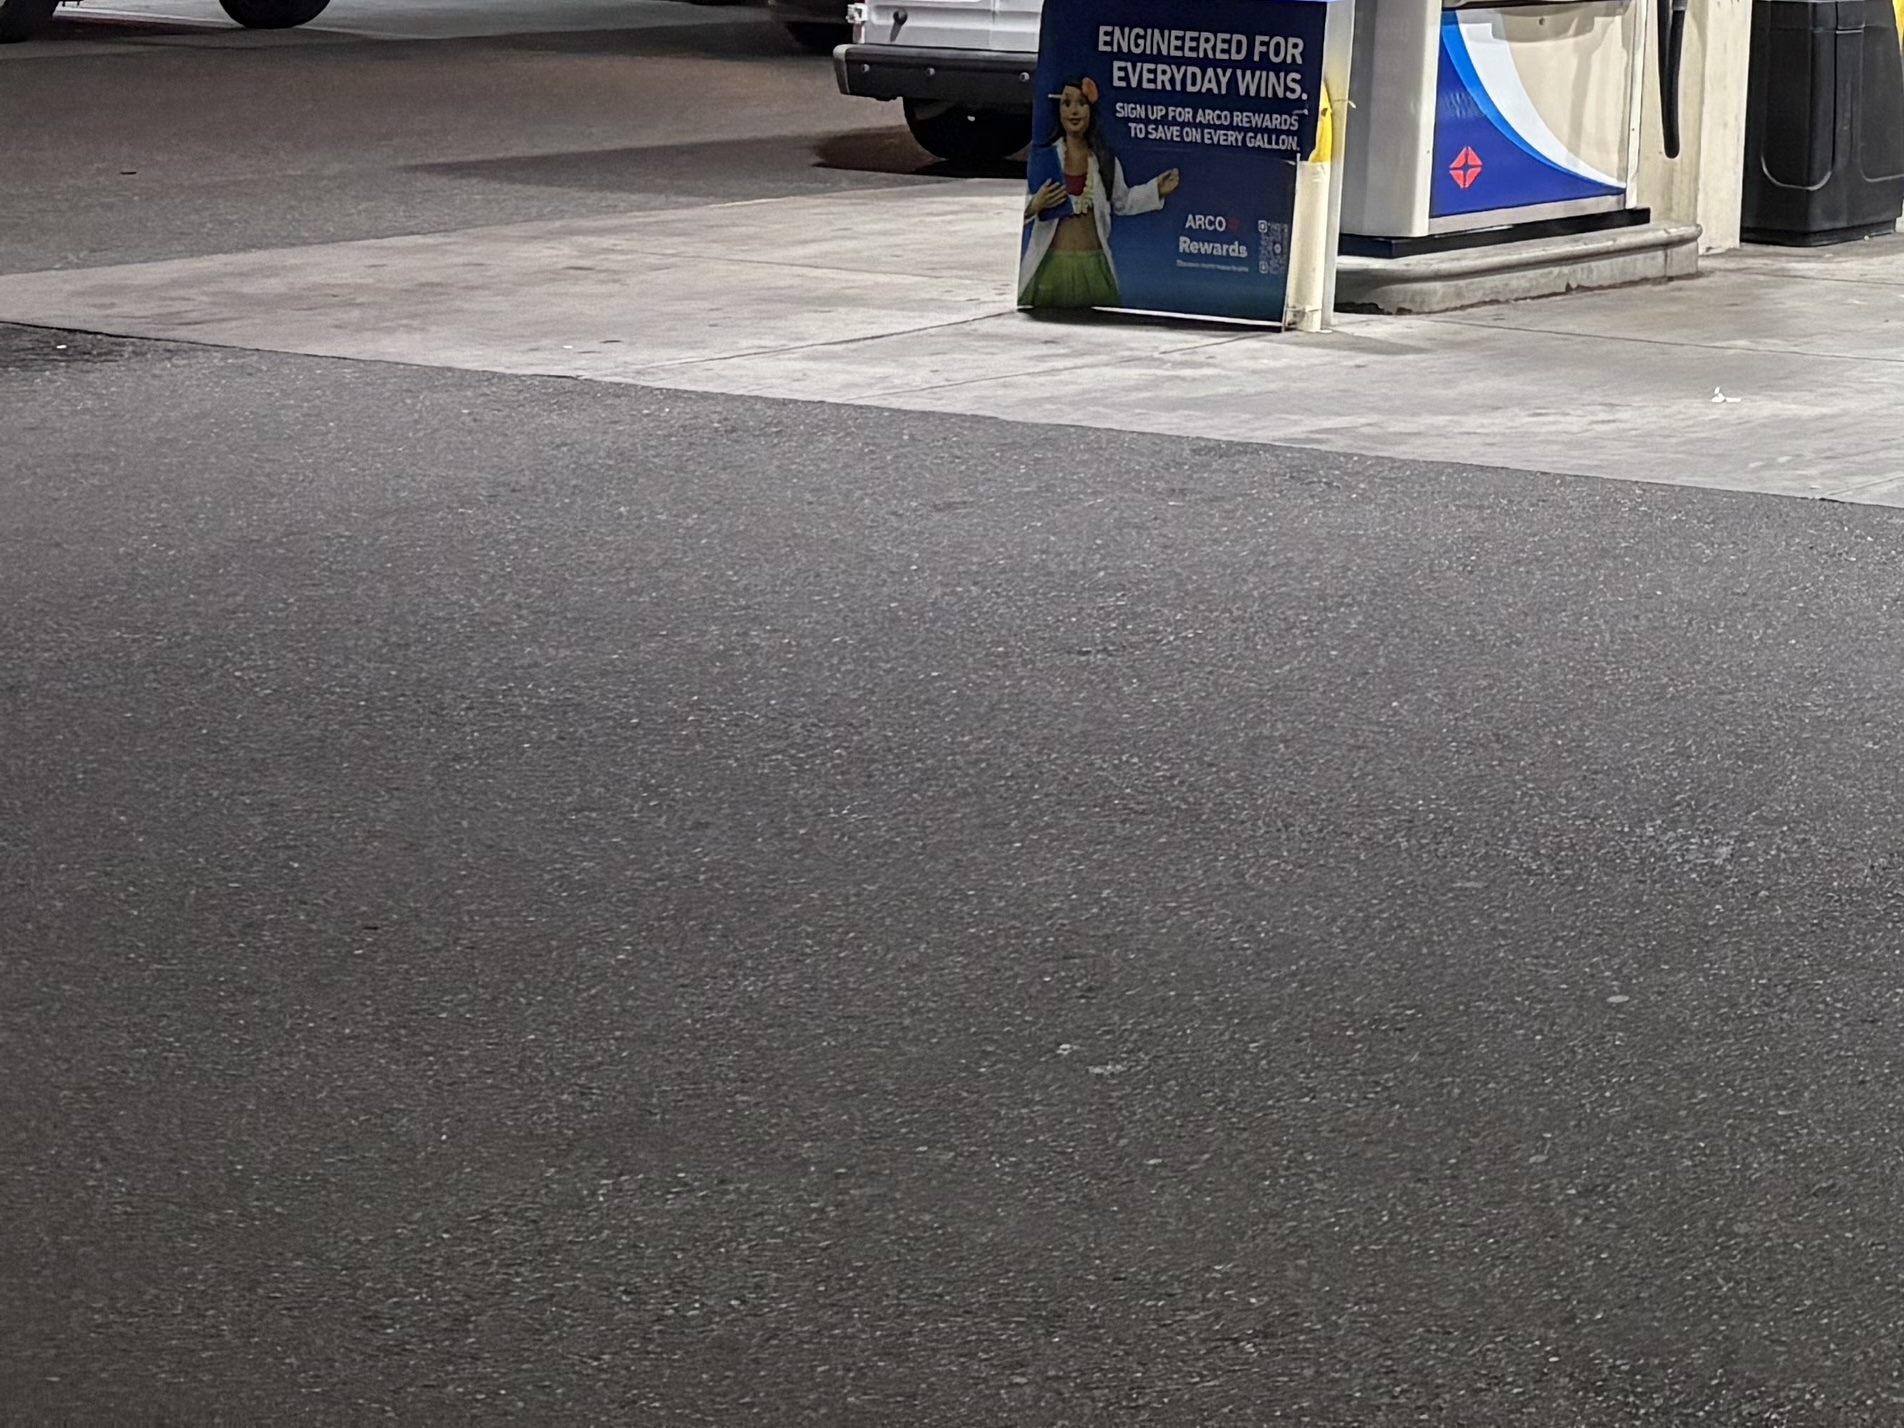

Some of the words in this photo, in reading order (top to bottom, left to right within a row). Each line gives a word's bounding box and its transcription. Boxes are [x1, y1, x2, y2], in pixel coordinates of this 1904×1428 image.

[1098, 25, 1247, 61] ENGINEERED
[1253, 35, 1304, 64] FOR
[1112, 60, 1232, 94] EVERYDAY
[1236, 69, 1308, 100] WINS.
[1115, 102, 1145, 119] SIGN
[1147, 105, 1166, 121] UP
[1168, 106, 1193, 123] FOR
[1196, 109, 1230, 126] ARCO
[1232, 112, 1299, 131] REWARDS
[1128, 122, 1145, 139] TO
[1147, 124, 1181, 142] SAVE
[1183, 127, 1201, 144] ON
[1203, 129, 1244, 147] EVERY
[1246, 132, 1300, 151] GALLON.
[1185, 213, 1226, 232] ARCO
[1179, 236, 1248, 257] Rewards
